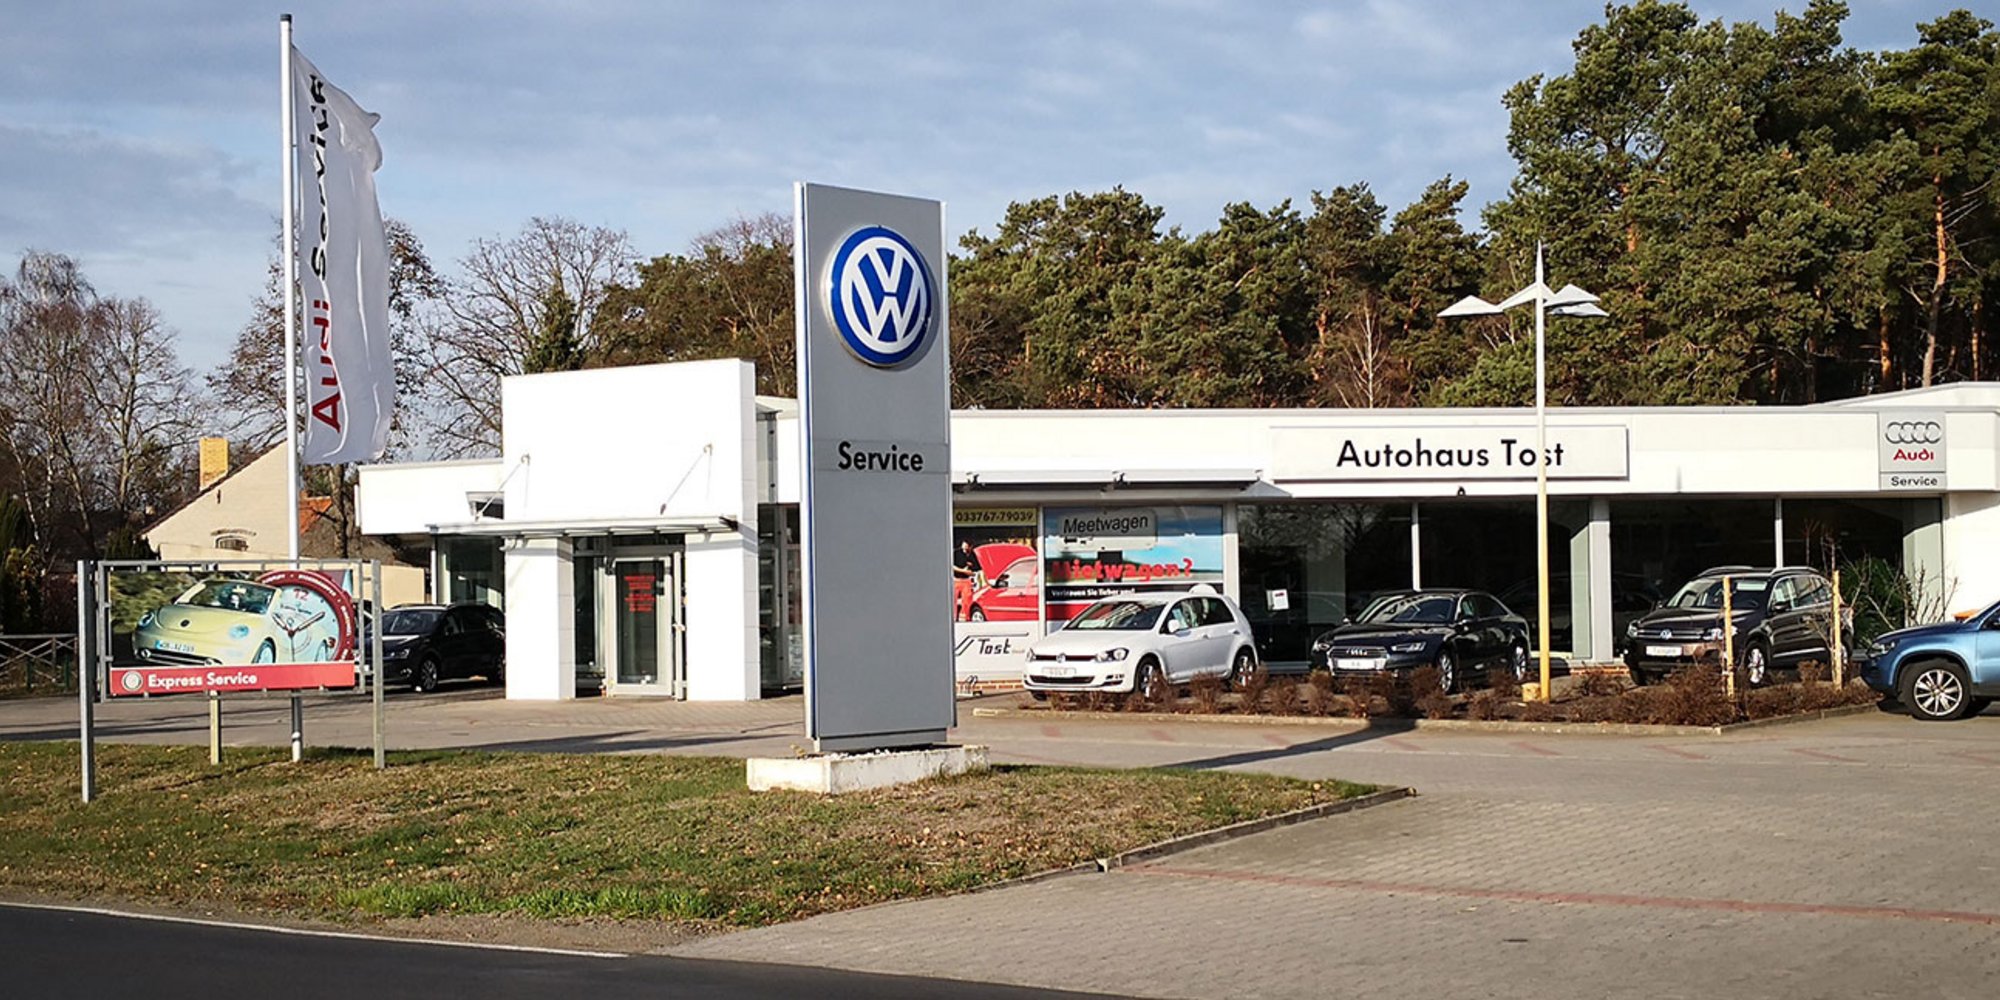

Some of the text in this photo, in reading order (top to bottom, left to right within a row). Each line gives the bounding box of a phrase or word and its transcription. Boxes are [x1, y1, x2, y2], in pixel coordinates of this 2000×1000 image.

[838, 441, 923, 472] Service
[1336, 438, 1490, 467] Autohaus
[1893, 448, 1934, 461] Audi
[1891, 476, 1938, 487] Service
[1063, 515, 1148, 534] Meetwagen
[978, 638, 1011, 654] Tost
[148, 672, 257, 689] Express Service
